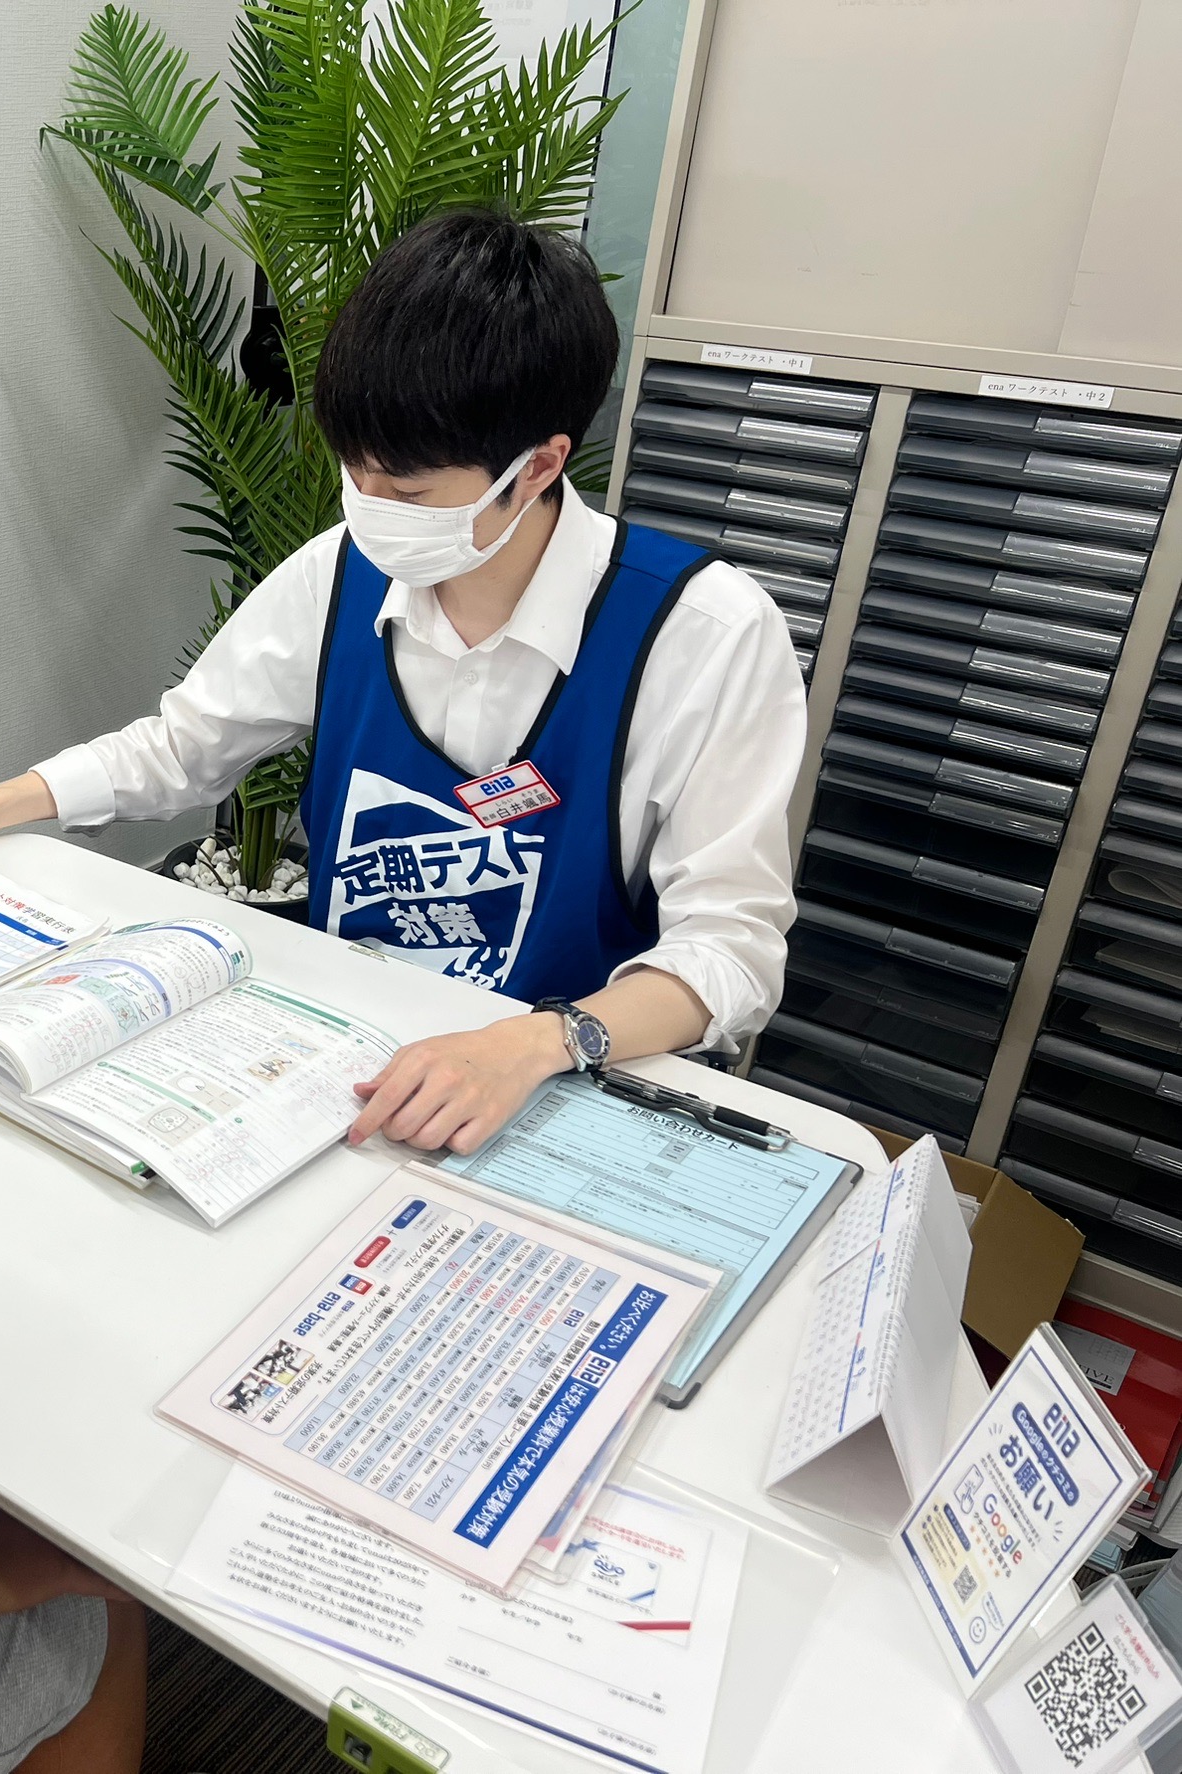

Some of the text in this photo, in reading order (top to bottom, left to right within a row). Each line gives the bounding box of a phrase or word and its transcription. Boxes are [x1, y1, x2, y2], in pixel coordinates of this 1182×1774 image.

[707, 350, 721, 358] ena
[724, 351, 774, 364] ワークテスト
[987, 383, 1004, 391] ena
[1008, 384, 1068, 397] ワークテスト
[480, 776, 516, 796] ena
[335, 830, 545, 905] 定期テスト
[387, 902, 487, 945] 対策
[627, 1106, 741, 1150] お問い合わせカード
[401, 1222, 451, 1269] ダブル学習システム
[442, 1259, 461, 1273] なし
[588, 1277, 607, 1292] 学年
[290, 1290, 345, 1338] ena-base
[407, 1293, 430, 1313] 22,000
[561, 1308, 585, 1328] ena
[597, 1288, 658, 1355] お比べください。
[372, 1332, 396, 1352] 16,500
[524, 1341, 549, 1368] アカデミー
[578, 1355, 612, 1385] ena
[258, 1359, 324, 1424] 充実の定期テスト対策
[335, 1372, 360, 1394] 22,000
[343, 1388, 367, 1409] 45,980
[358, 1395, 382, 1416] 37,730
[373, 1402, 397, 1424] 30,580
[389, 1410, 413, 1432] 57,750
[297, 1415, 321, 1437] 11,000
[404, 1417, 428, 1439] 57,750
[420, 1424, 444, 1447] 33,220
[1043, 1402, 1081, 1458] ena
[305, 1431, 329, 1453] 36,190
[320, 1438, 345, 1461] 30,690
[437, 1432, 460, 1454] 18,040
[336, 1447, 360, 1469] 27,170
[351, 1454, 376, 1477] 32,780
[463, 1380, 592, 1542] は安心授業料で本気の受験対策
[1017, 1409, 1075, 1501] Googleのクチコミの
[367, 1462, 391, 1485] 21,780
[383, 1471, 407, 1493] 14,300
[1000, 1434, 1054, 1520] お願い
[400, 1480, 422, 1500] 7,260
[423, 1473, 456, 1508] スクール21
[983, 1493, 1022, 1565] Google
[974, 1511, 1012, 1579] クチコミを投稿する
